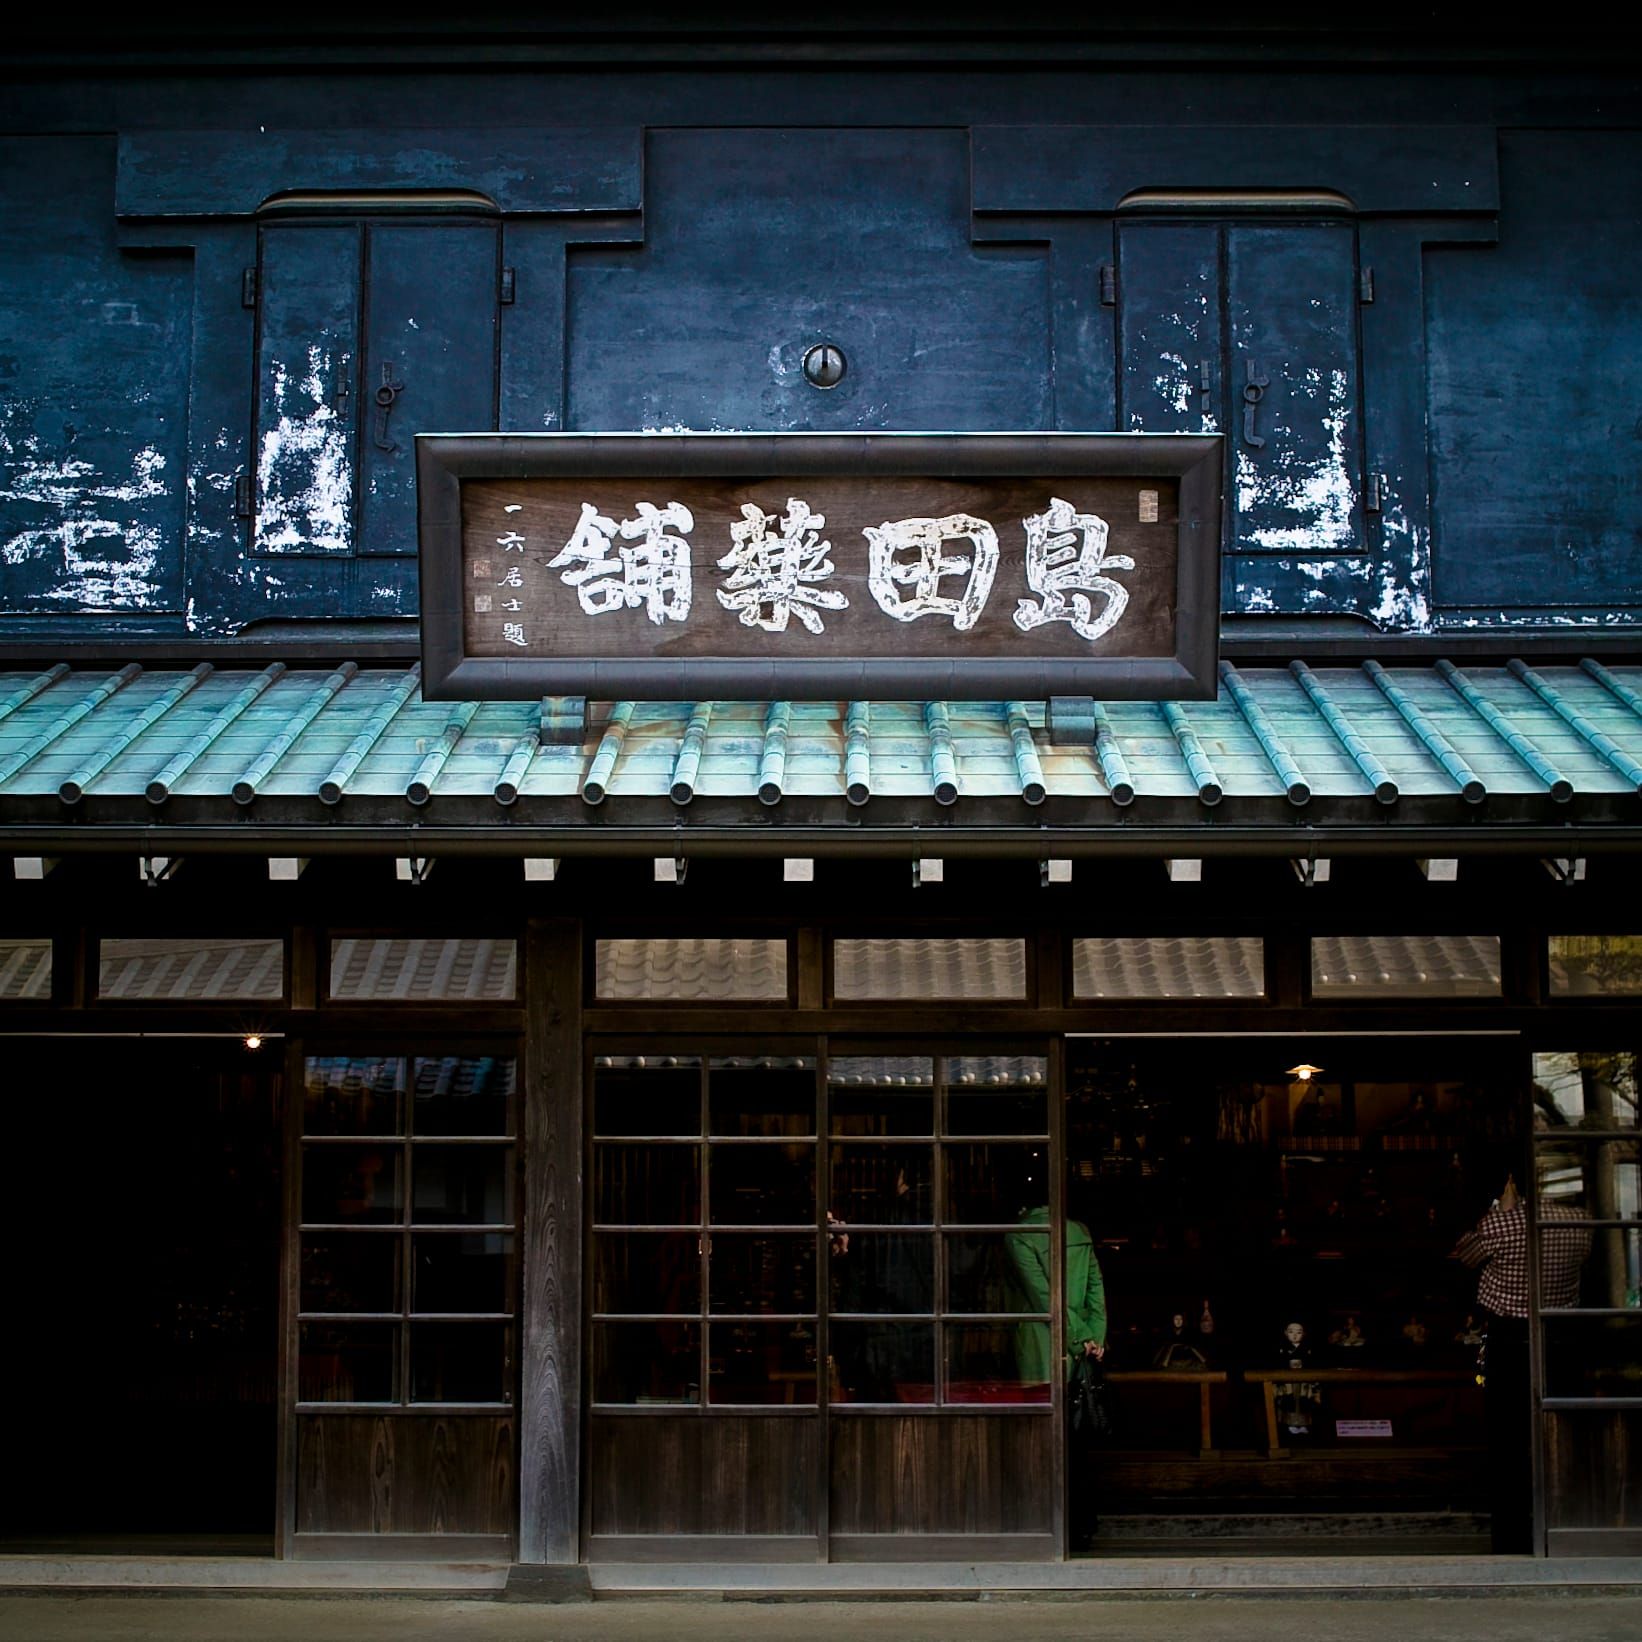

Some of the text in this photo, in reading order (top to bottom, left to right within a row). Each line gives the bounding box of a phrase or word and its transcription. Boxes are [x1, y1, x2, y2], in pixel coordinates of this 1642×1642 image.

[496, 504, 528, 647] 一六居士題
